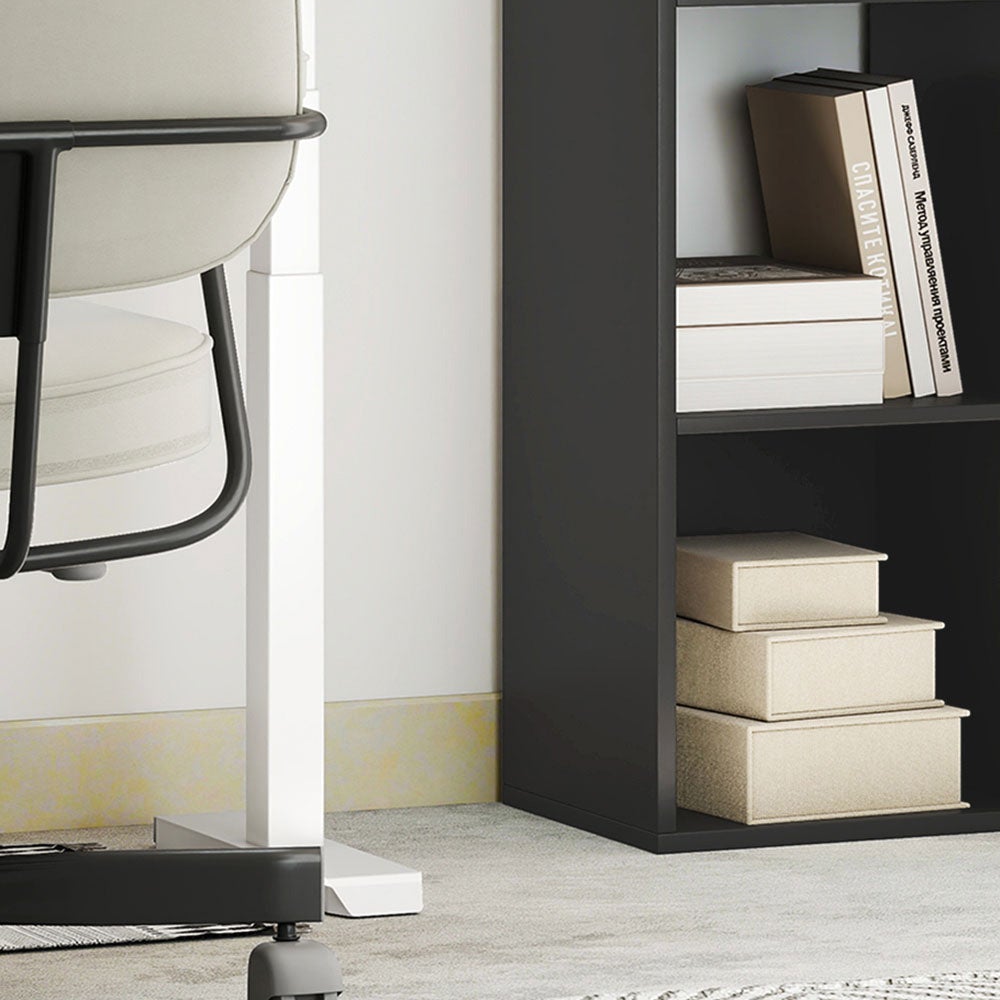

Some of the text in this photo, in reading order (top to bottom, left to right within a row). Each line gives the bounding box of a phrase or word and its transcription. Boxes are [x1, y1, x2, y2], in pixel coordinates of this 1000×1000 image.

[852, 161, 883, 250] СПАСИТЕ
[914, 190, 952, 373] Метод управления проектами
